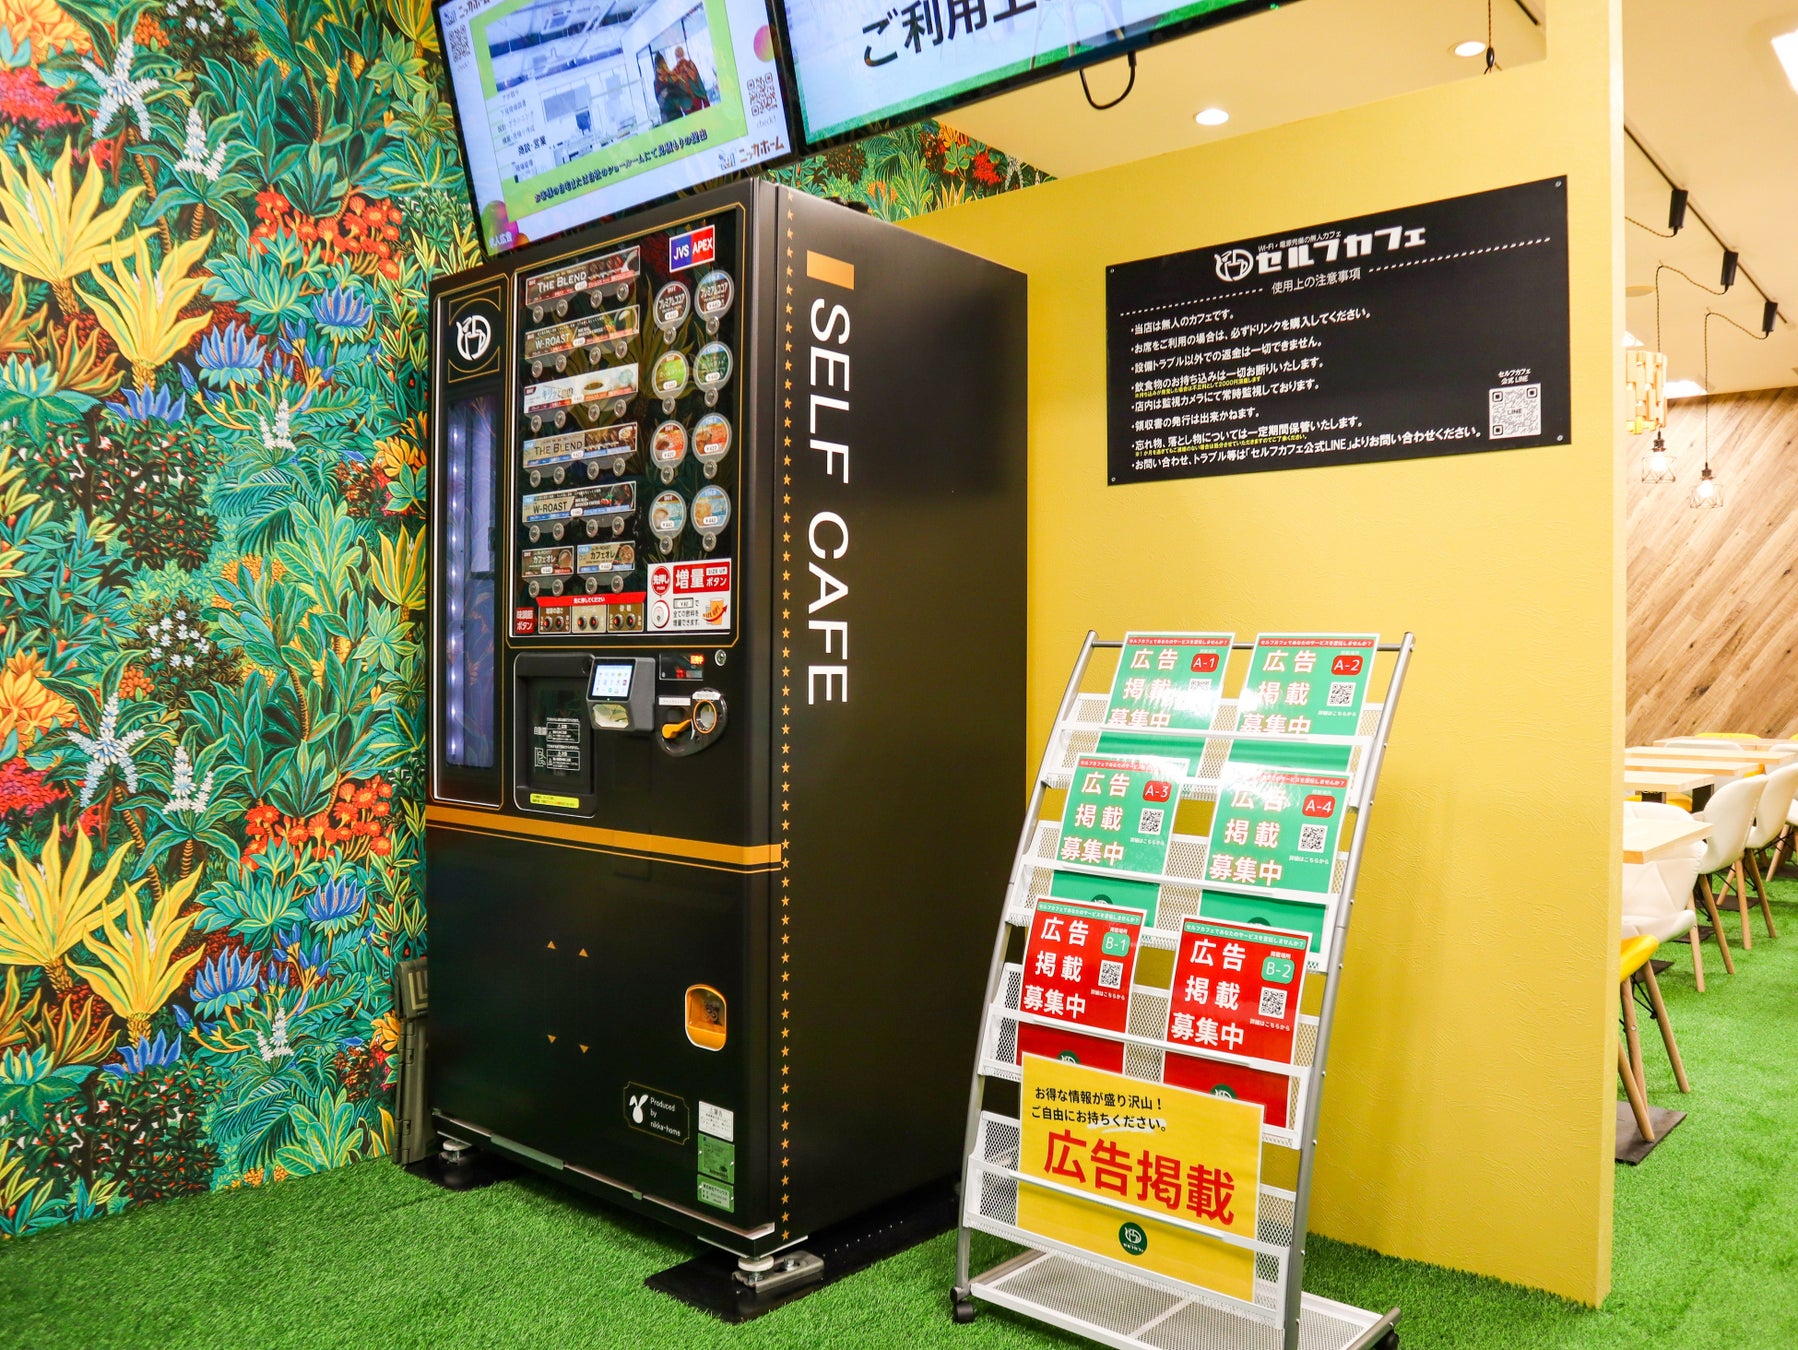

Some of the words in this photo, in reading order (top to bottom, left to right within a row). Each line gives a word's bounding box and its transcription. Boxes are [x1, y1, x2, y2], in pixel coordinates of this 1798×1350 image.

[863, 0, 1037, 66] ご利用
[739, 136, 785, 163] ニッカホーム
[673, 244, 690, 260] JVS
[692, 237, 713, 255] APEX
[1255, 225, 1426, 274] セルフカフェ
[537, 281, 555, 293] THE
[556, 271, 587, 287] BLEND
[1272, 267, 1361, 295] 使用上の注意事項
[535, 333, 570, 350] W-ROAST
[809, 298, 851, 484] SELF
[534, 445, 552, 456] THE
[553, 441, 583, 454] BLEND
[533, 501, 568, 514] W-ROAST
[590, 550, 616, 560] カフェオレ
[675, 567, 705, 589] 増量
[706, 576, 727, 587] ボタン
[807, 511, 849, 706] CAFE
[516, 621, 533, 631] ボタン
[1130, 648, 1179, 671] 広告
[1192, 657, 1215, 669] A-1
[1262, 649, 1317, 673] 広告
[1333, 659, 1361, 672] A-2
[1122, 677, 1172, 702] 掲載
[1258, 681, 1311, 706] 掲載
[1107, 707, 1172, 728] 募集中
[1239, 713, 1312, 734] 募集中
[1081, 771, 1130, 798] 広告
[1145, 785, 1169, 798] A-3
[1074, 803, 1124, 832] 掲載
[1305, 799, 1332, 814] A-4
[1224, 818, 1281, 849] 掲載
[1060, 836, 1125, 867] 募集中
[1209, 854, 1283, 887] 募集中
[1040, 916, 1089, 947] 広告
[1105, 936, 1127, 952] B-1
[1190, 938, 1247, 972] 広告
[1035, 950, 1083, 983] 掲載
[1265, 961, 1292, 979] B-2
[1023, 984, 1087, 1020] 募集中
[1184, 975, 1241, 1011] 掲載
[1170, 1012, 1245, 1051] 募集中
[650, 1097, 676, 1112] Produced
[1035, 1087, 1162, 1111] お得な情報が盛り沢山！
[650, 1109, 658, 1119] by
[1031, 1105, 1167, 1132] ご自由にお持ちください。
[1043, 1129, 1235, 1226] 広告掲載
